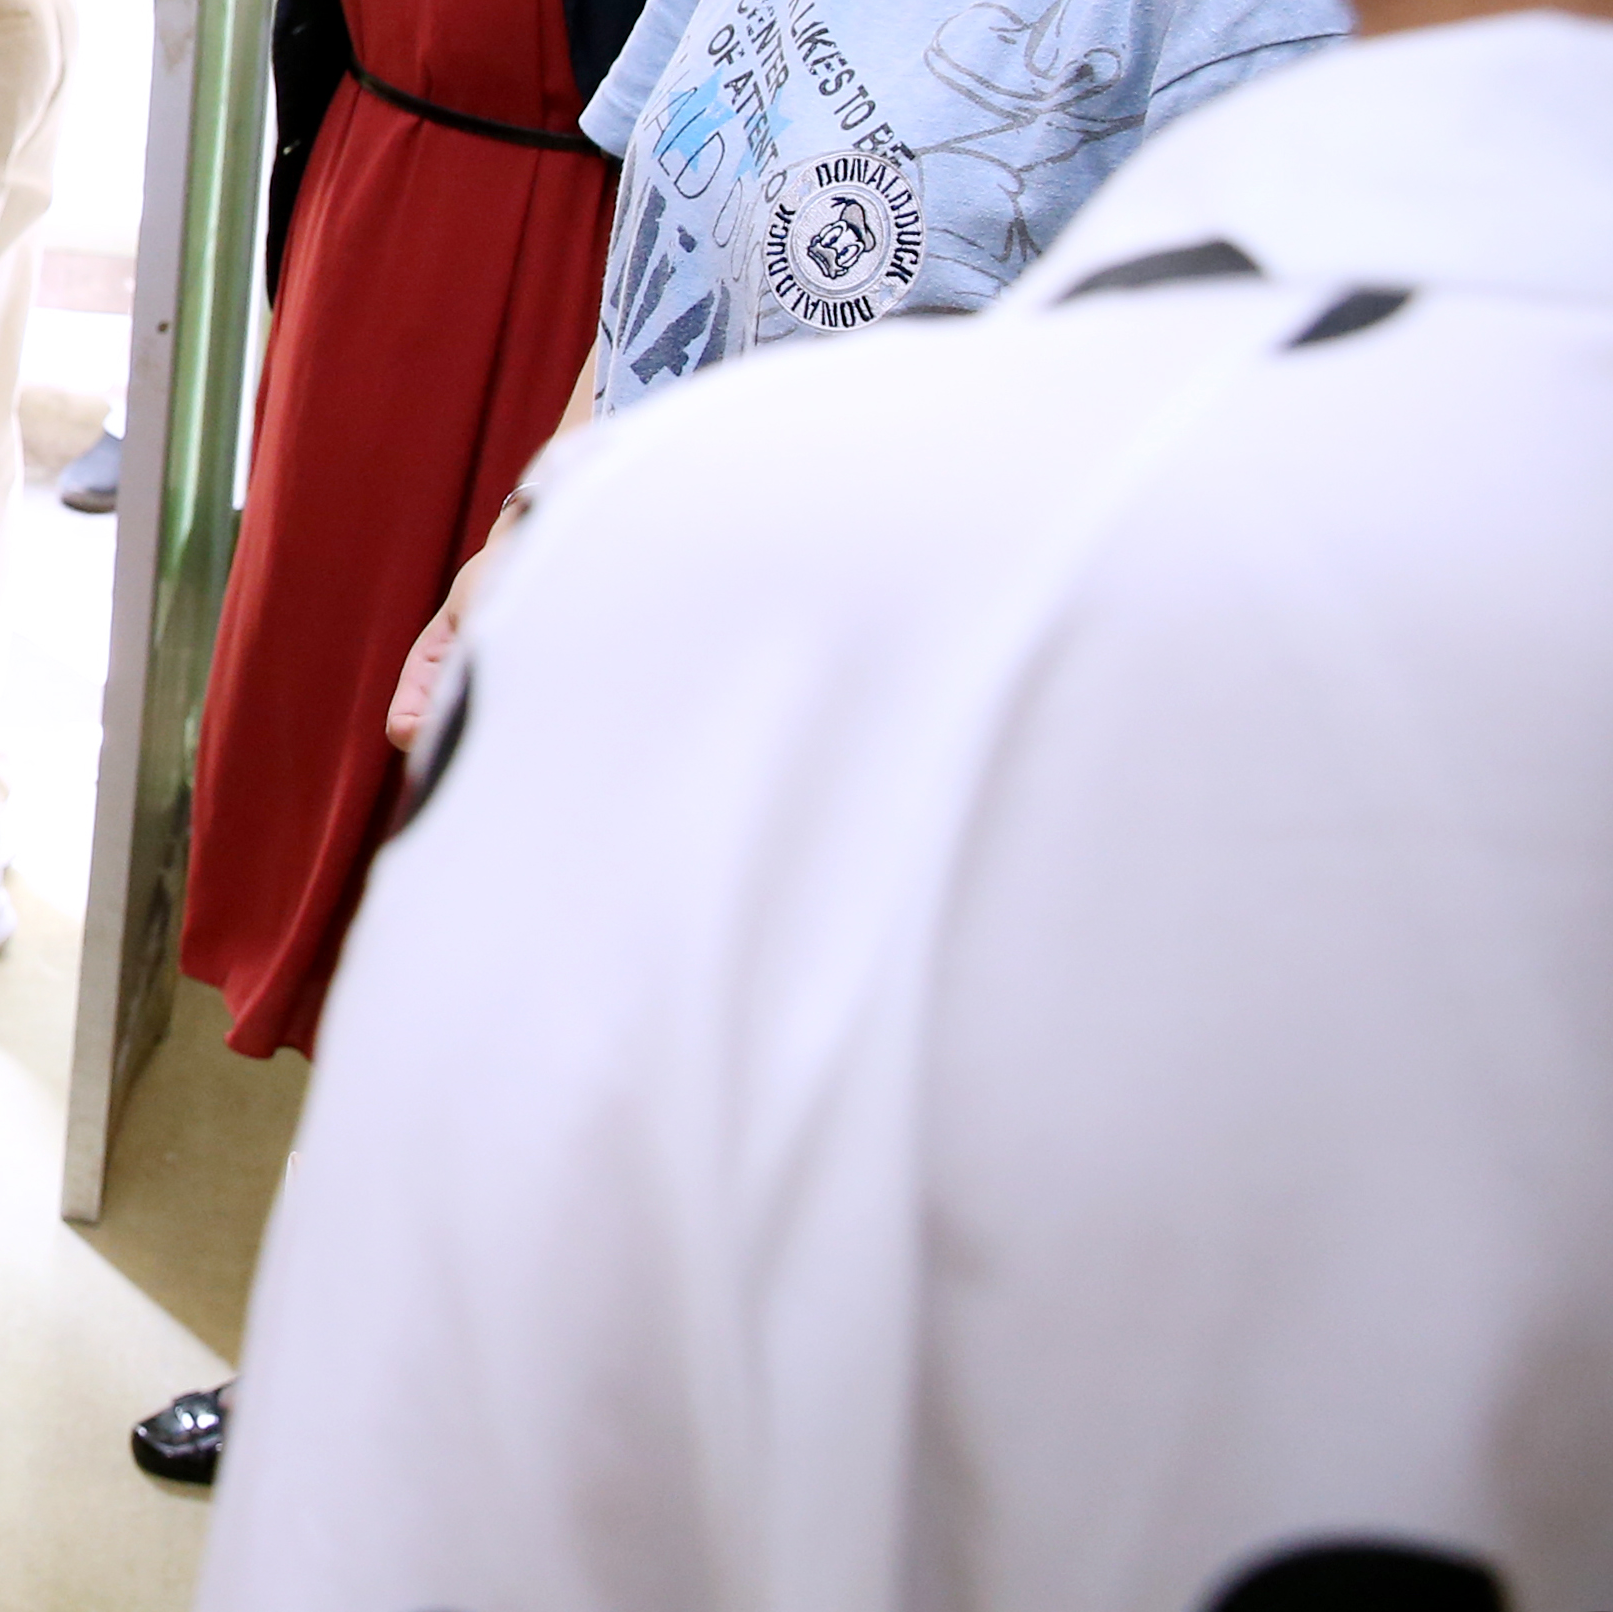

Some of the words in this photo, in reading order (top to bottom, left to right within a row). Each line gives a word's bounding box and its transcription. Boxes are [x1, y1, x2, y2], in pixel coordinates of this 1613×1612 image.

[707, 24, 745, 67] OF
[791, 2, 855, 97] LIKES
[833, 84, 876, 131] TO
